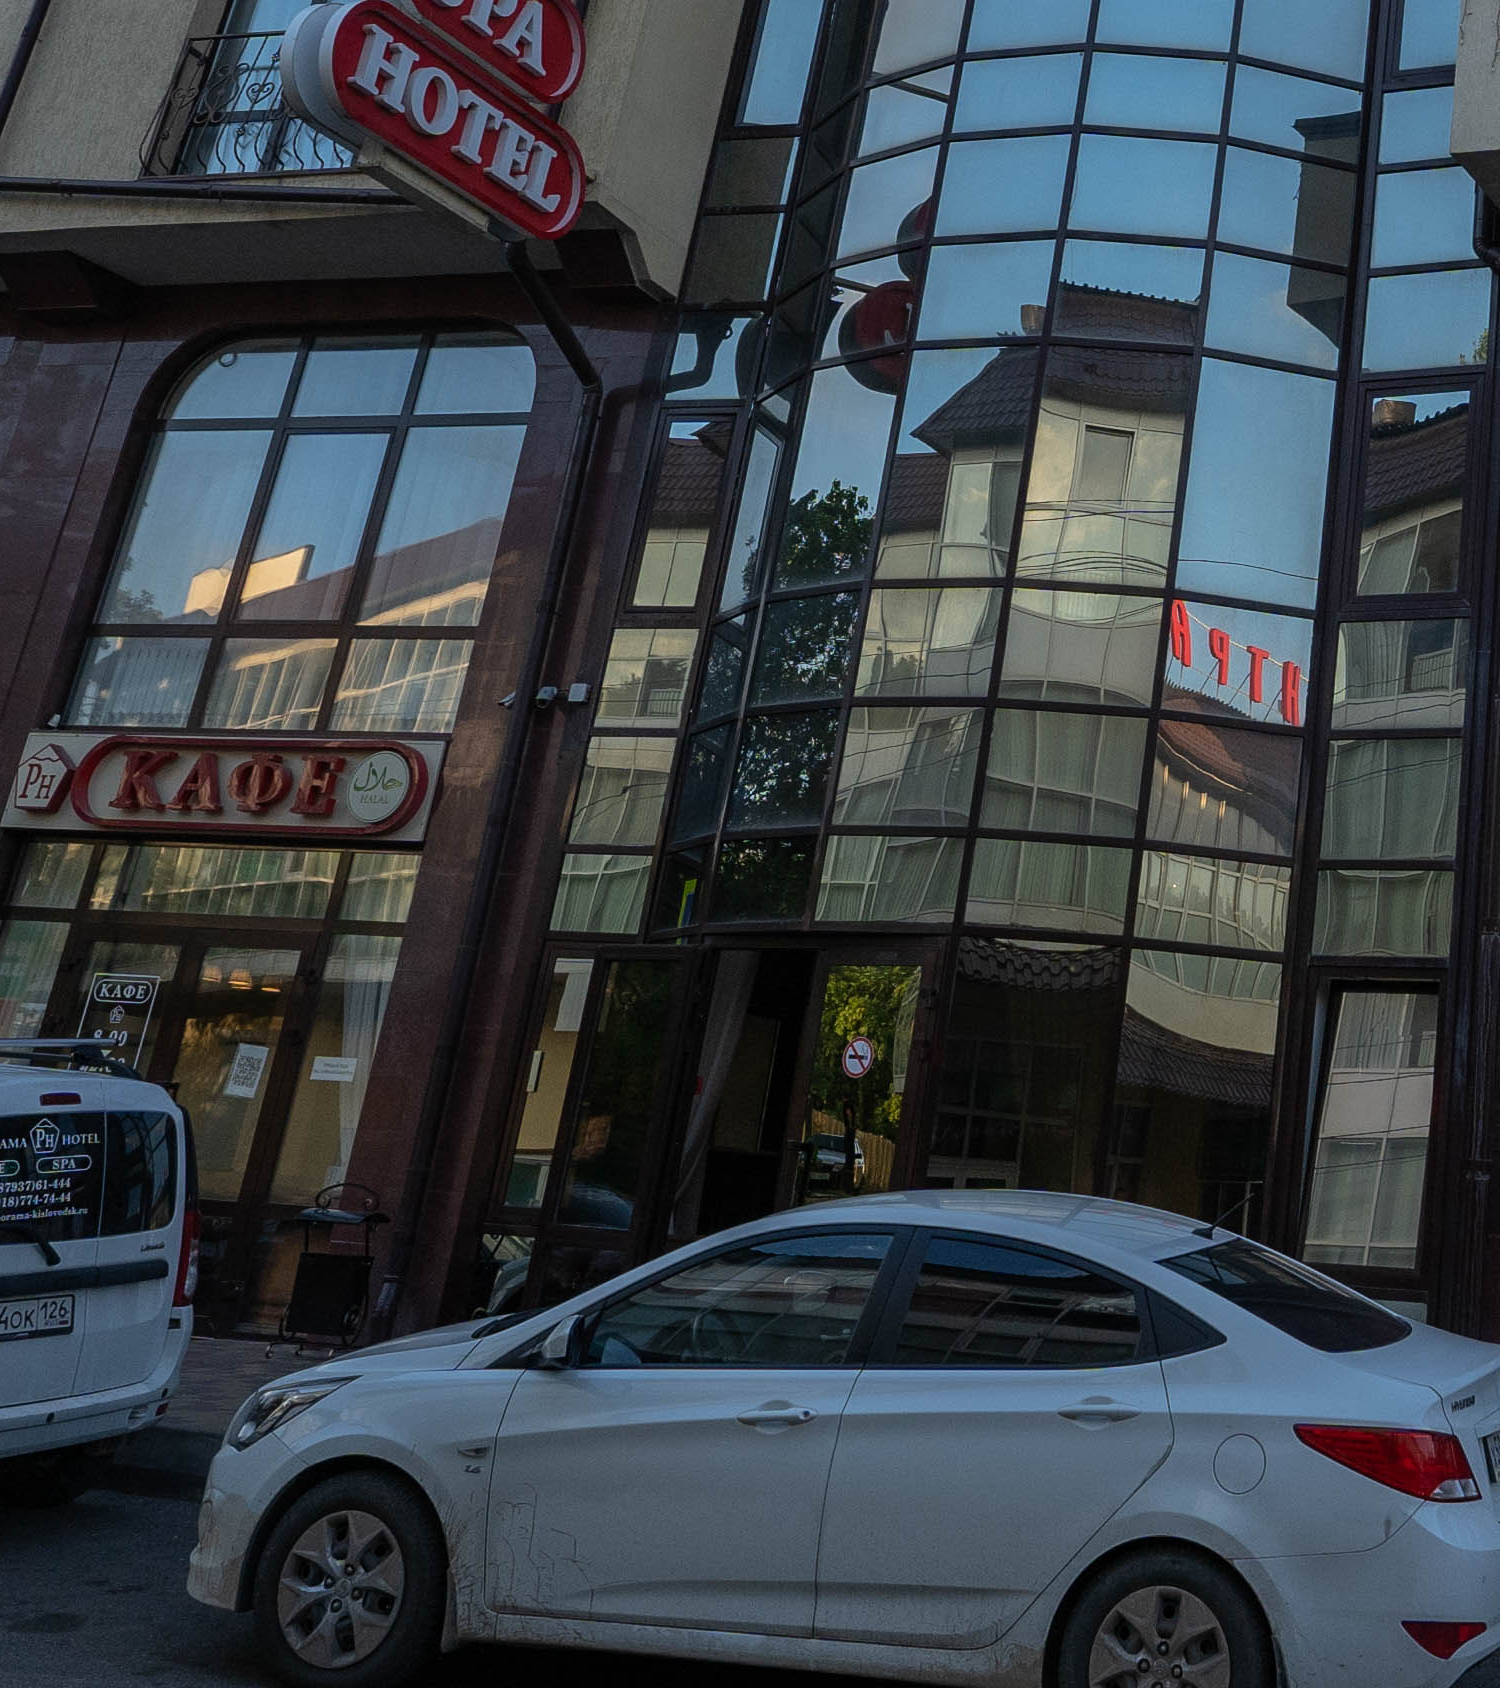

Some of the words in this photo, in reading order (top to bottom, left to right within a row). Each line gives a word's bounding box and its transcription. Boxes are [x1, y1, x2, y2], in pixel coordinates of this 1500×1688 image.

[347, 23, 561, 212] HOTEL
[19, 762, 51, 800] PH
[108, 750, 346, 814] КАФЕ
[99, 983, 147, 999] КАФЕ
[36, 1128, 55, 1148] PH
[62, 1132, 100, 1145] HOTEL
[52, 1159, 76, 1170] SPA
[40, 1300, 68, 1319] 126
